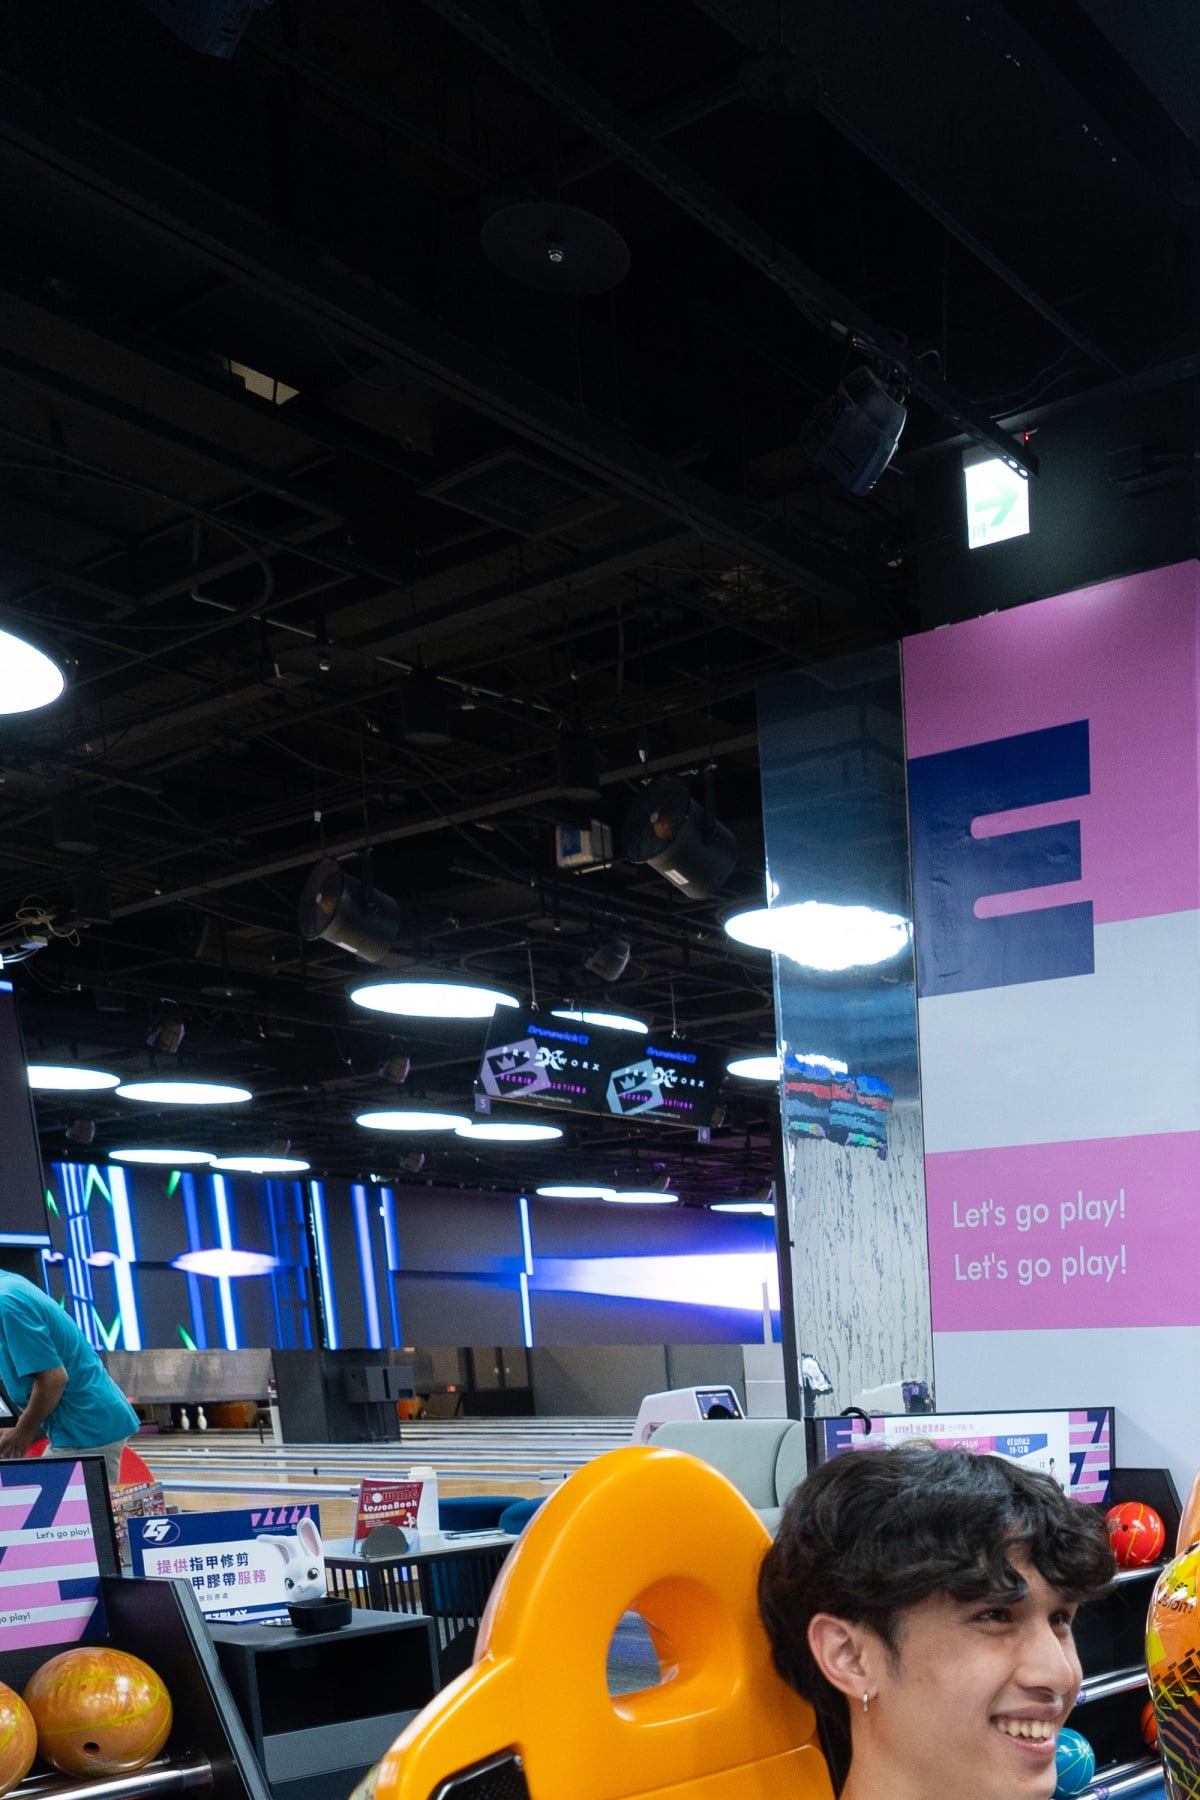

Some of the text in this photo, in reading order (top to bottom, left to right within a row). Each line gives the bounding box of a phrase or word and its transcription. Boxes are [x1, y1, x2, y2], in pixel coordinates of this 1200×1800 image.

[908, 719, 1095, 998] E
[953, 1188, 1125, 1232] Let's go play!
[955, 1244, 1126, 1286] Let's go play!
[36, 1527, 90, 1540] Let's go play!
[156, 1552, 249, 1575] 提供指甲修剪
[10, 1612, 31, 1624] play!
